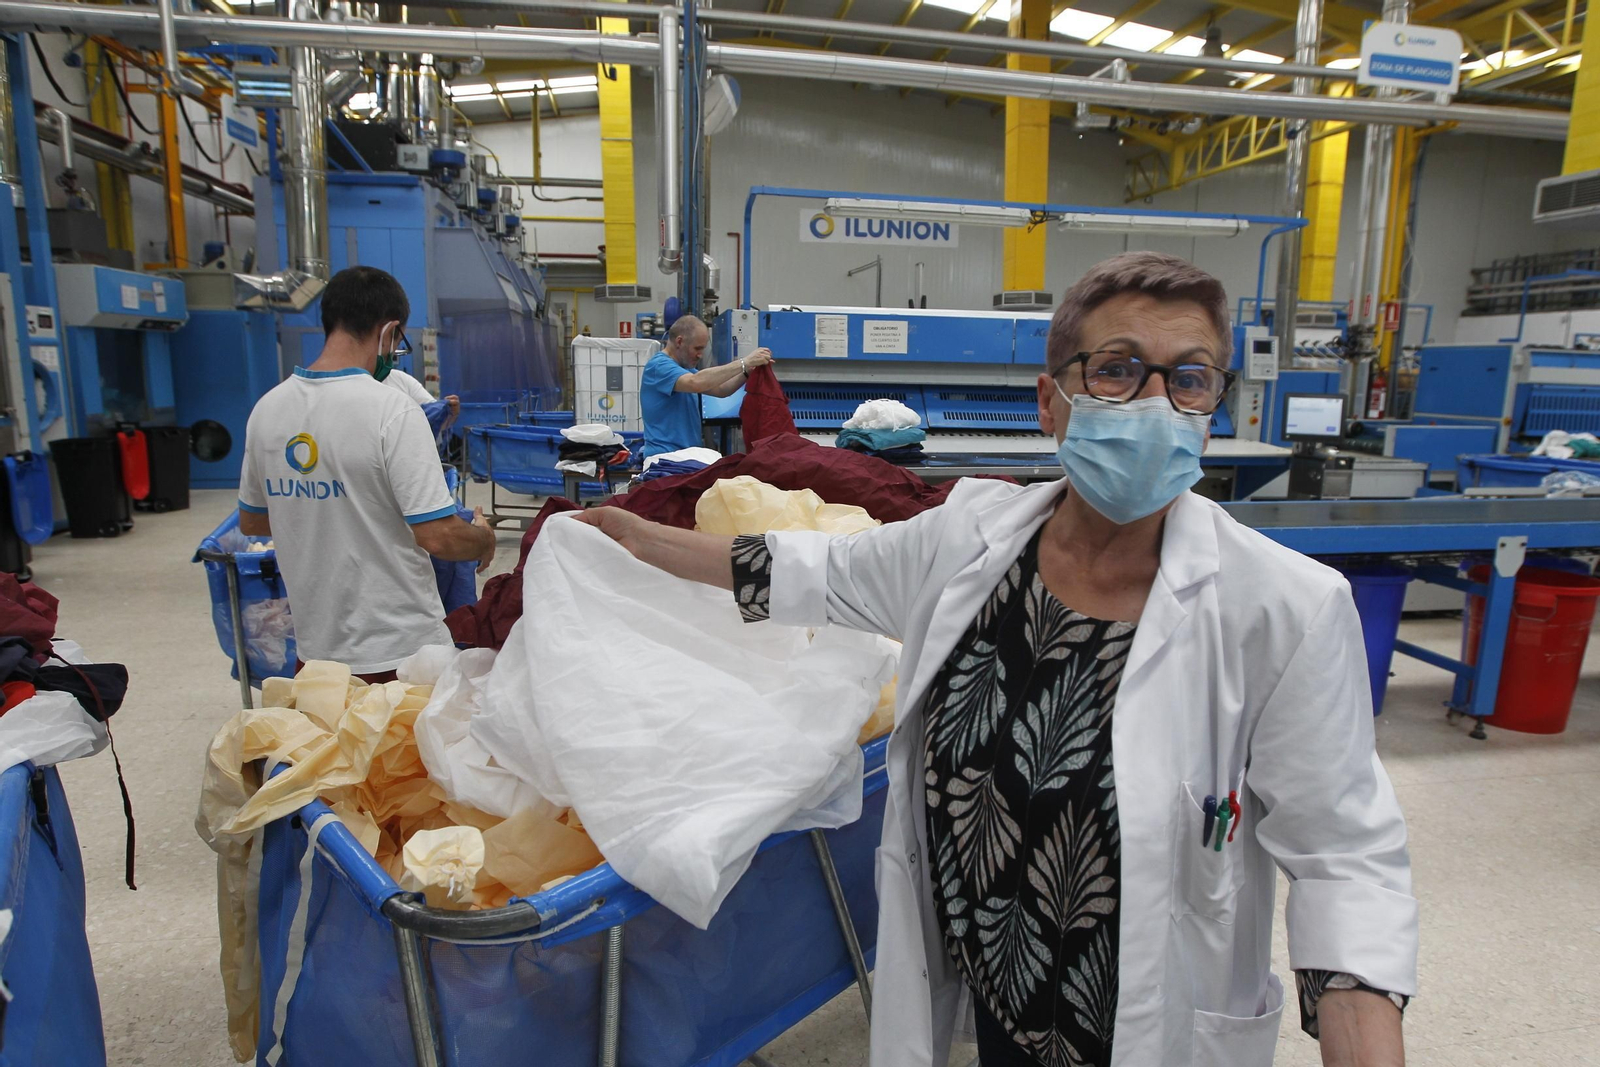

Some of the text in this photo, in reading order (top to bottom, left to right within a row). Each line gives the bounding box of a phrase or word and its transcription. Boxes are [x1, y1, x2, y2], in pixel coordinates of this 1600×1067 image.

[1371, 61, 1392, 72] ZONA
[845, 217, 950, 241] ILUNION
[587, 412, 626, 422] ILUNION
[266, 478, 347, 499] LUNION
